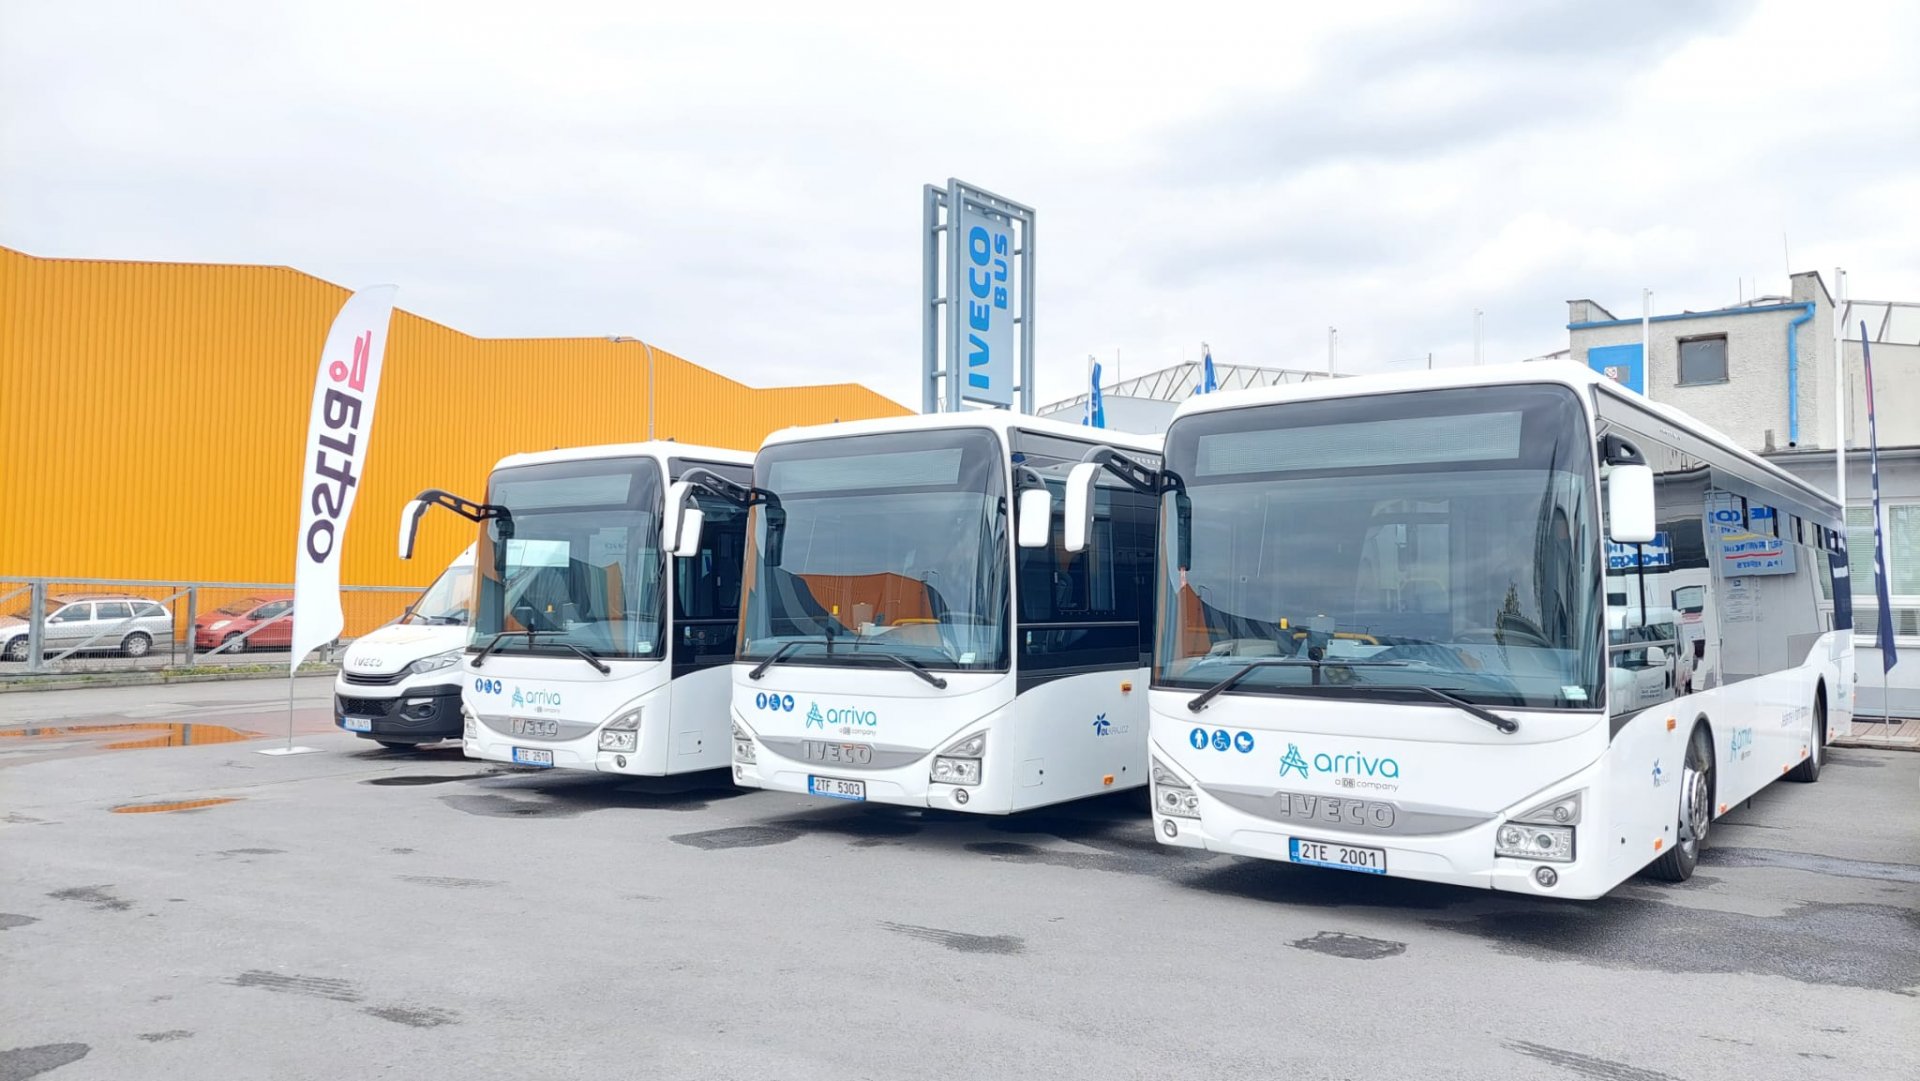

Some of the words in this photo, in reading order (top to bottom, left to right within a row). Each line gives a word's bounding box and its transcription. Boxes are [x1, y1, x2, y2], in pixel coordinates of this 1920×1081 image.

[994, 233, 1008, 310] BUS
[969, 226, 991, 390] IVECO
[526, 689, 561, 706] arriva
[511, 718, 558, 737] IVECO
[826, 706, 877, 727] arriva
[803, 741, 872, 764] IVECO
[1314, 751, 1399, 779] arriva
[815, 779, 831, 792] 2TF
[838, 781, 861, 796] 5303
[1357, 780, 1399, 792] company
[1280, 793, 1396, 829] IVECO
[1302, 843, 1328, 861] 2TE
[1340, 848, 1376, 867] 2001
